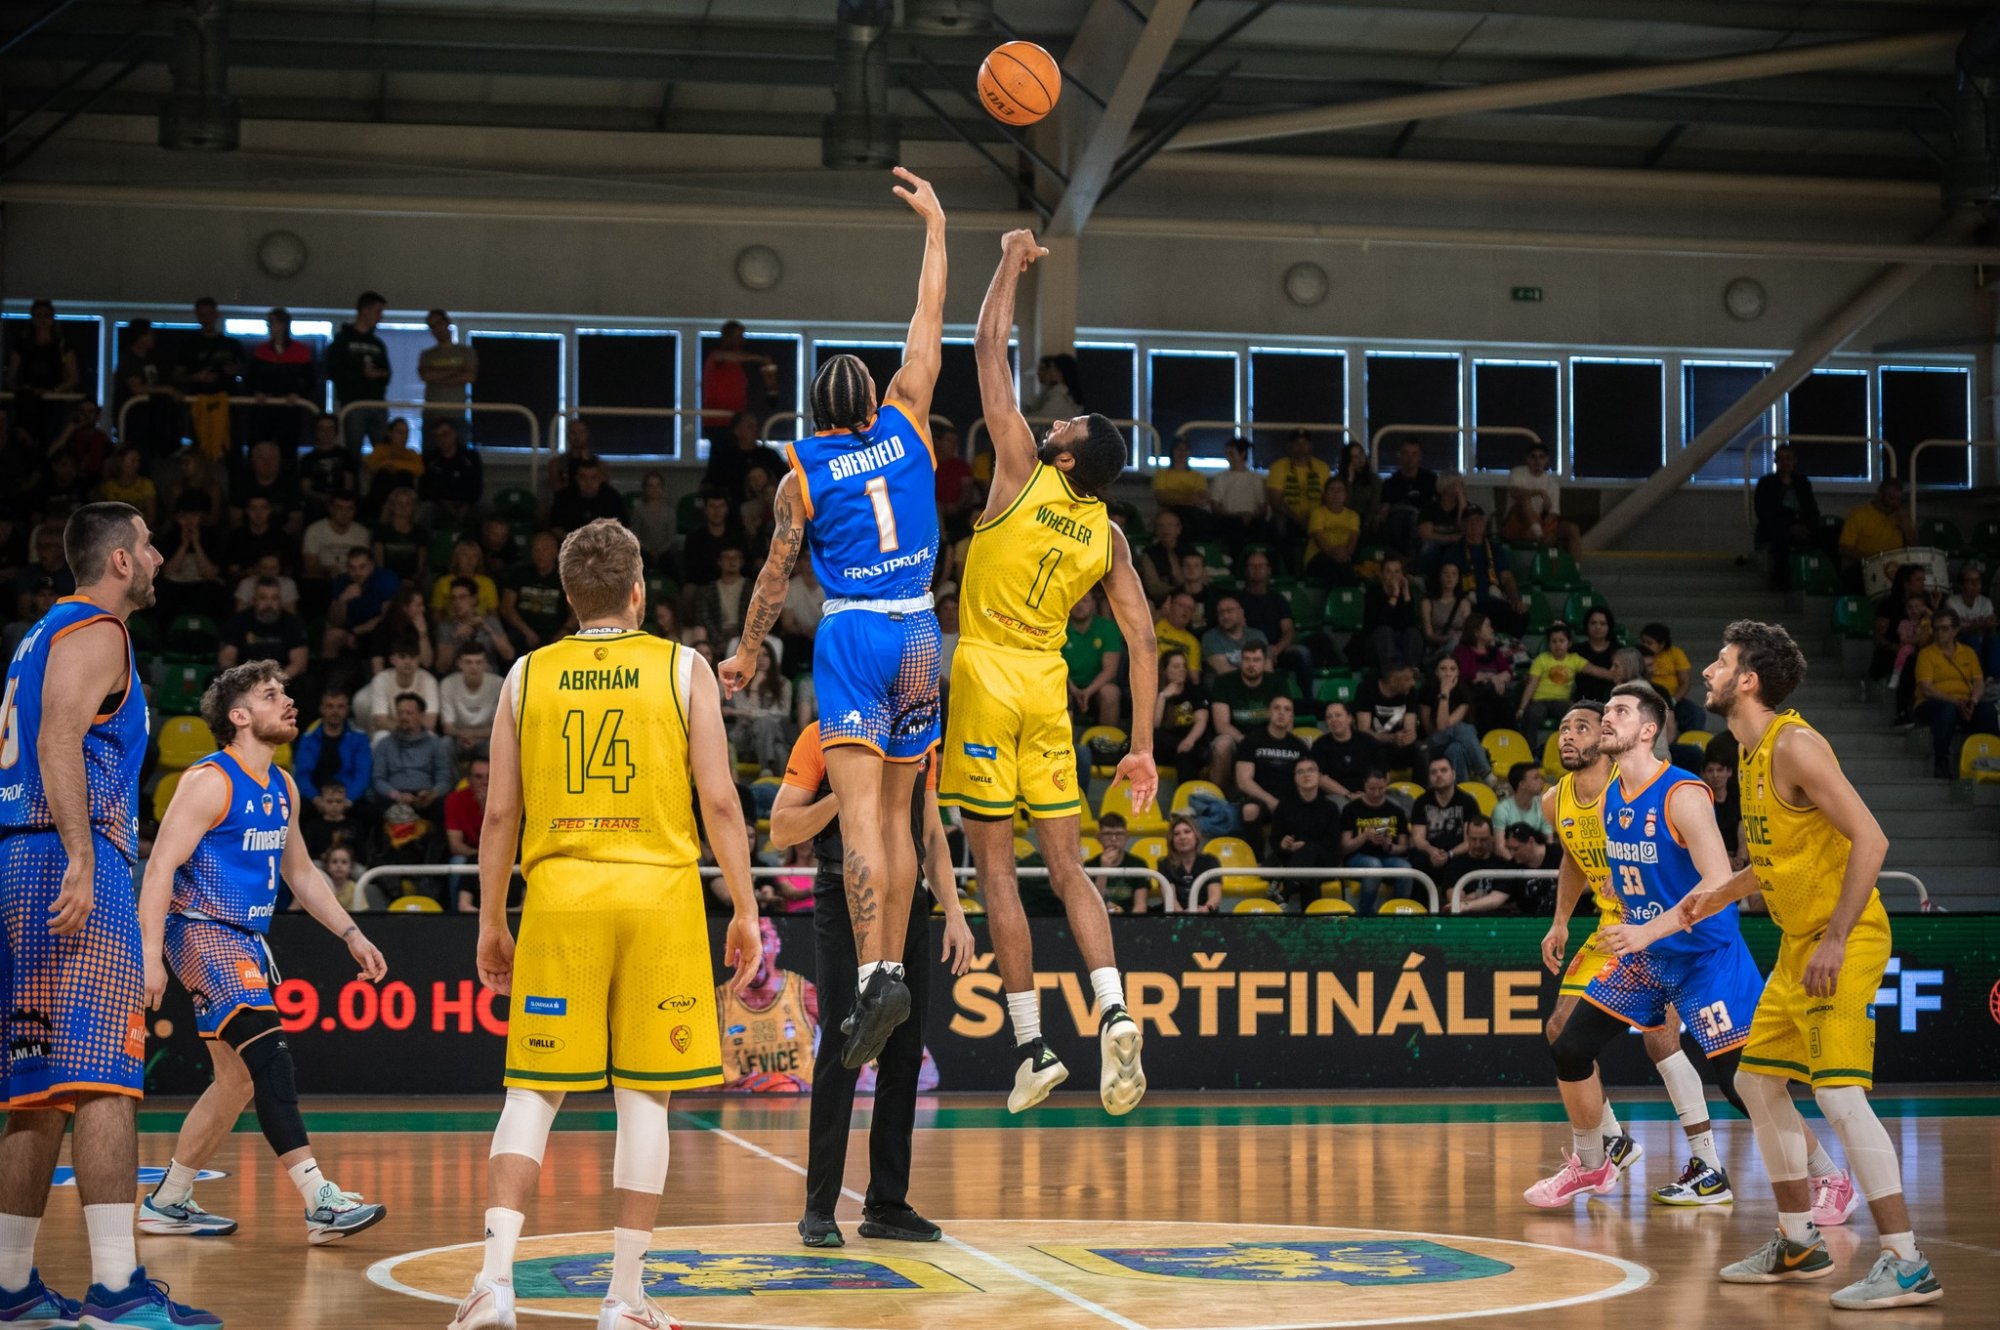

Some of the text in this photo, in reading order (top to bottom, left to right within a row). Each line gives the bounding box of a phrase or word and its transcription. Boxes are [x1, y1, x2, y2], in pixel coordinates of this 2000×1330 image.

[828, 435, 906, 482] SHERFIELD
[864, 475, 899, 553] 1
[1035, 505, 1092, 546] WHEELER
[1025, 547, 1063, 609] 1
[559, 665, 640, 690] ABRHÁM
[562, 709, 636, 794] 14
[1578, 815, 1600, 838] 33
[268, 855, 276, 891] 3
[1619, 865, 1646, 896] 33
[1699, 1000, 1733, 1037] 33
[529, 1038, 555, 1048] VIALLE
